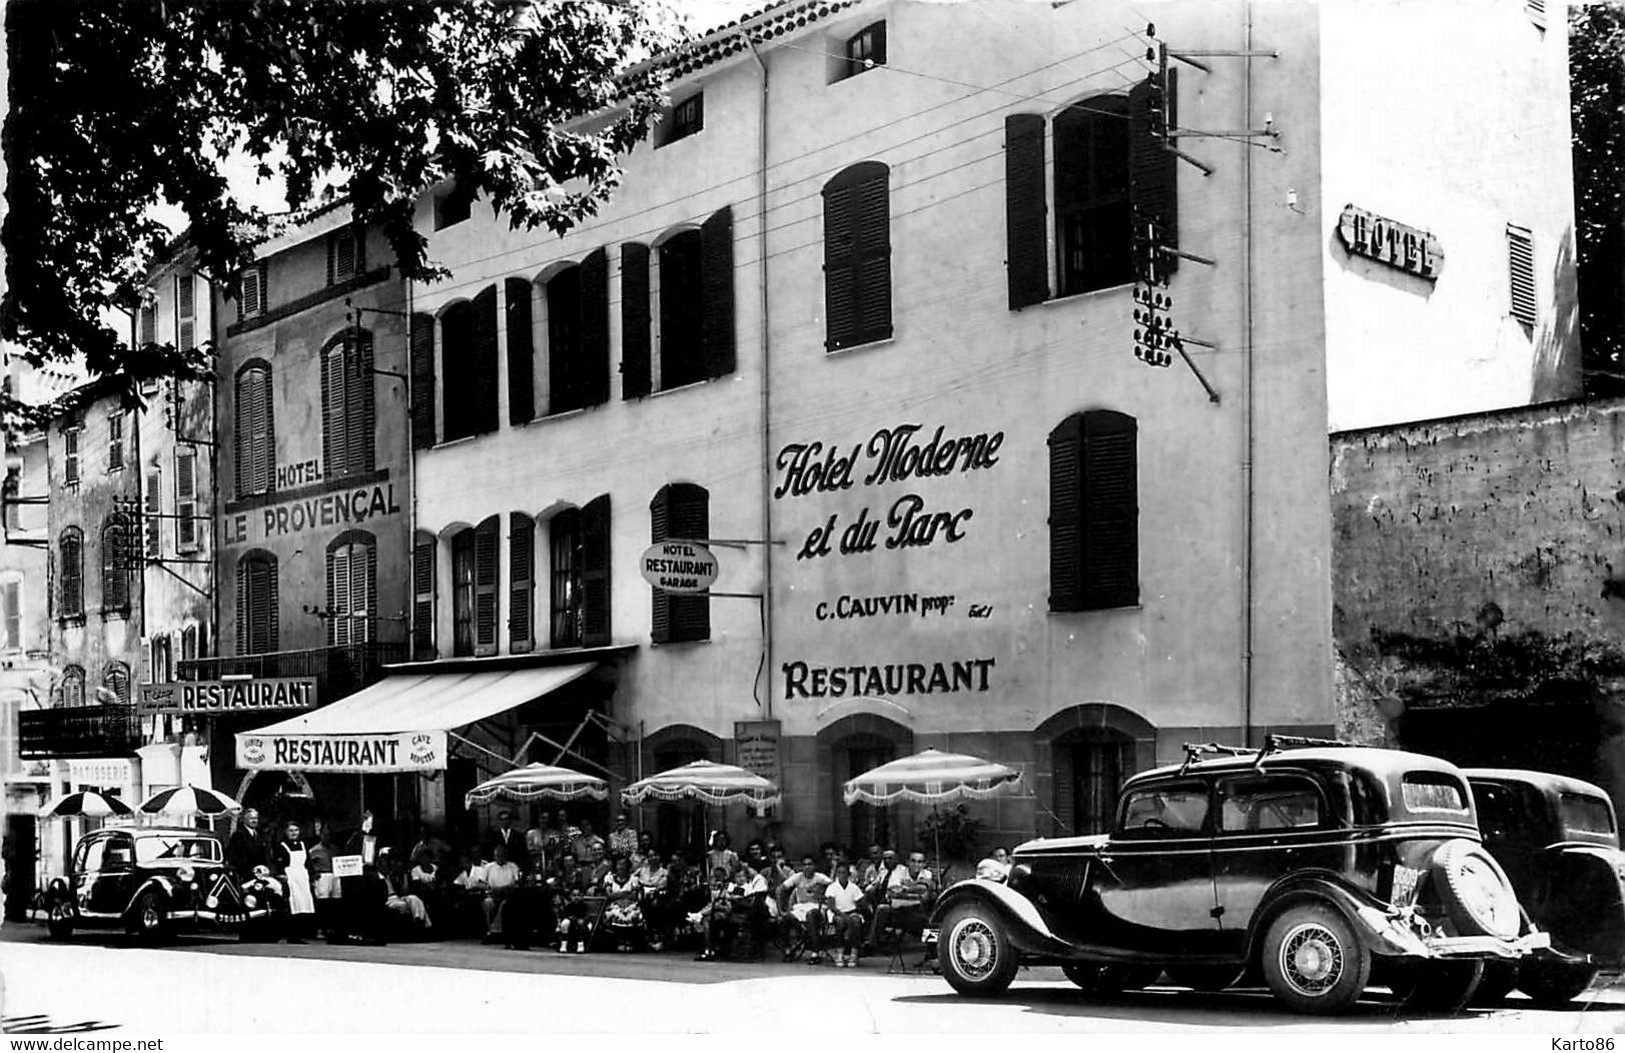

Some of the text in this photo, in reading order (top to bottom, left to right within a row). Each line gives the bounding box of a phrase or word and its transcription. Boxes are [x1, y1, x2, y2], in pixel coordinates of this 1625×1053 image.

[1353, 214, 1434, 273] HOTEL
[277, 459, 323, 489] HOTEL
[774, 424, 1004, 499] Hotel Moderne
[224, 483, 400, 545] LE PROVENÇAL
[796, 494, 973, 561] et du Parc
[663, 545, 696, 557] HOTEL
[646, 558, 713, 577] RESTAURANT
[660, 576, 698, 588] GARAGE
[781, 657, 996, 700] RESTAURANT
[182, 681, 313, 711] RESTAURANT
[273, 737, 400, 766] RESTAURANT
[411, 733, 432, 746] CAVE
